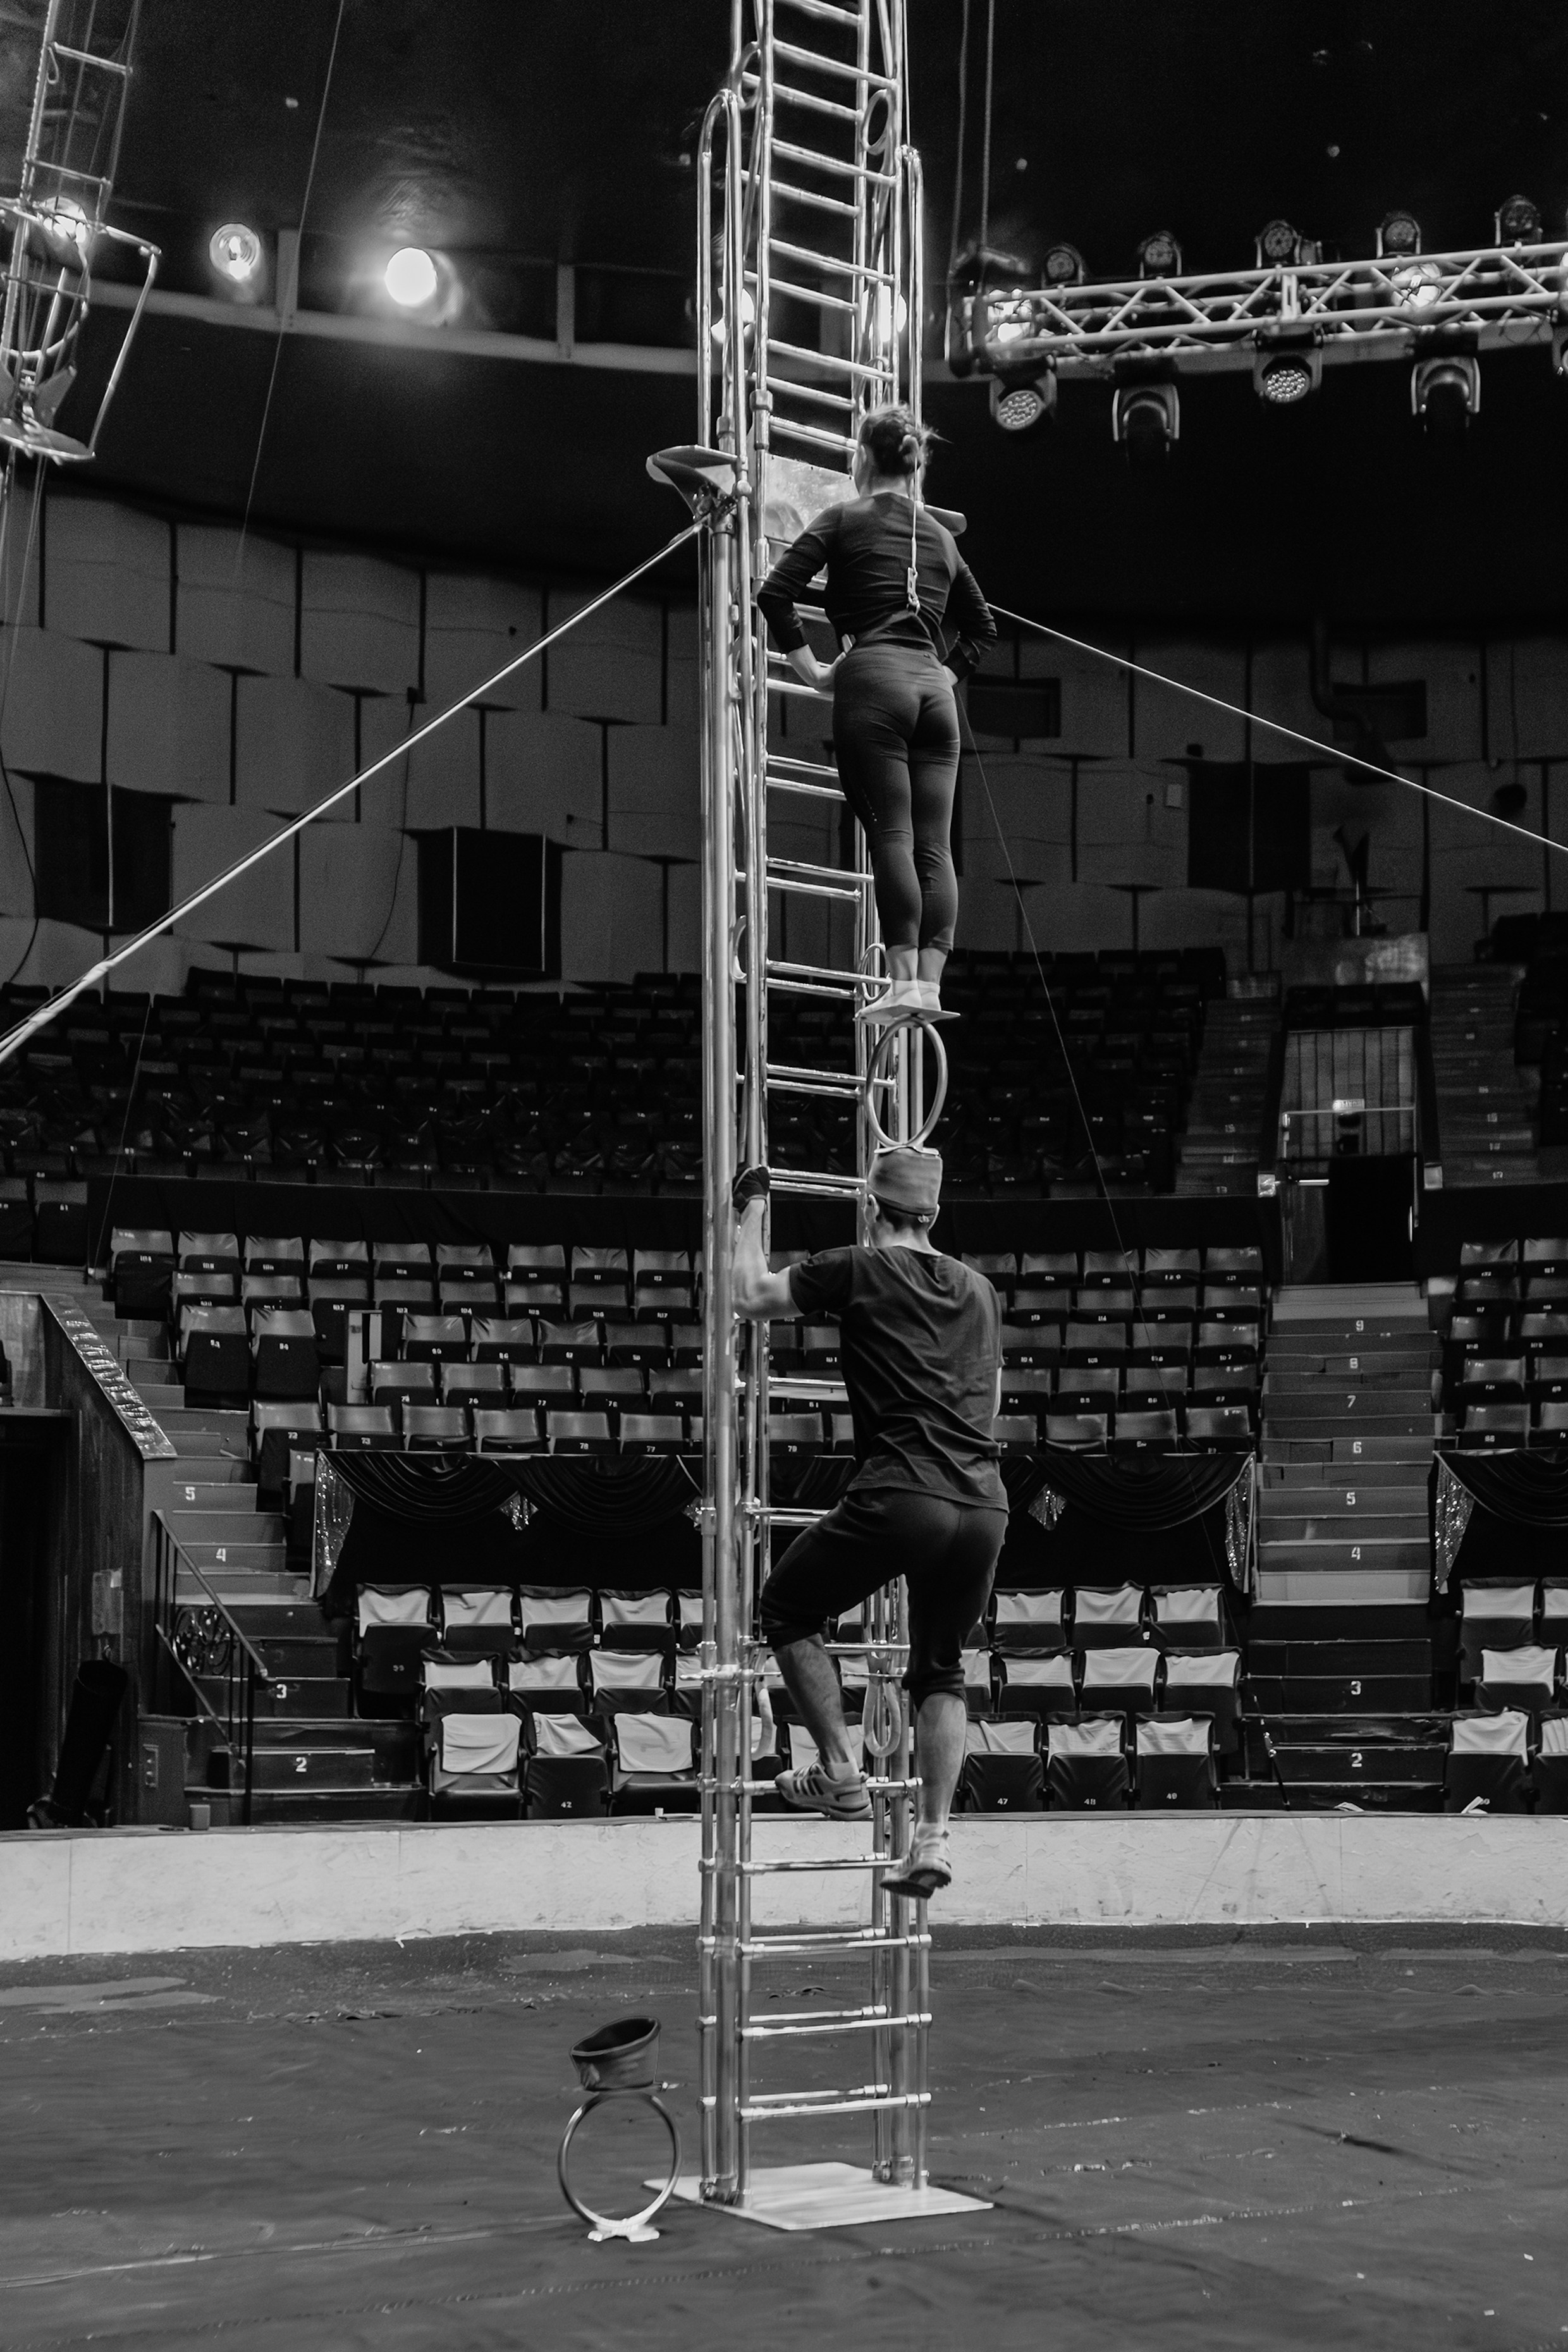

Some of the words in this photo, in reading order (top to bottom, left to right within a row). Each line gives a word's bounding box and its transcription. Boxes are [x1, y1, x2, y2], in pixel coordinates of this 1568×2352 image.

[1356, 1320, 1363, 1331] 9
[1350, 1358, 1357, 1368] 8
[1347, 1395, 1356, 1407] 7
[1354, 1442, 1361, 1453] 6
[185, 1487, 195, 1500] 5
[1347, 1492, 1356, 1505] 5
[216, 1548, 226, 1561] 4
[1352, 1547, 1360, 1560] 4
[277, 1684, 286, 1698] 3
[1351, 1681, 1361, 1694] 3
[296, 1757, 307, 1772] 2
[1352, 1753, 1362, 1767] 2
